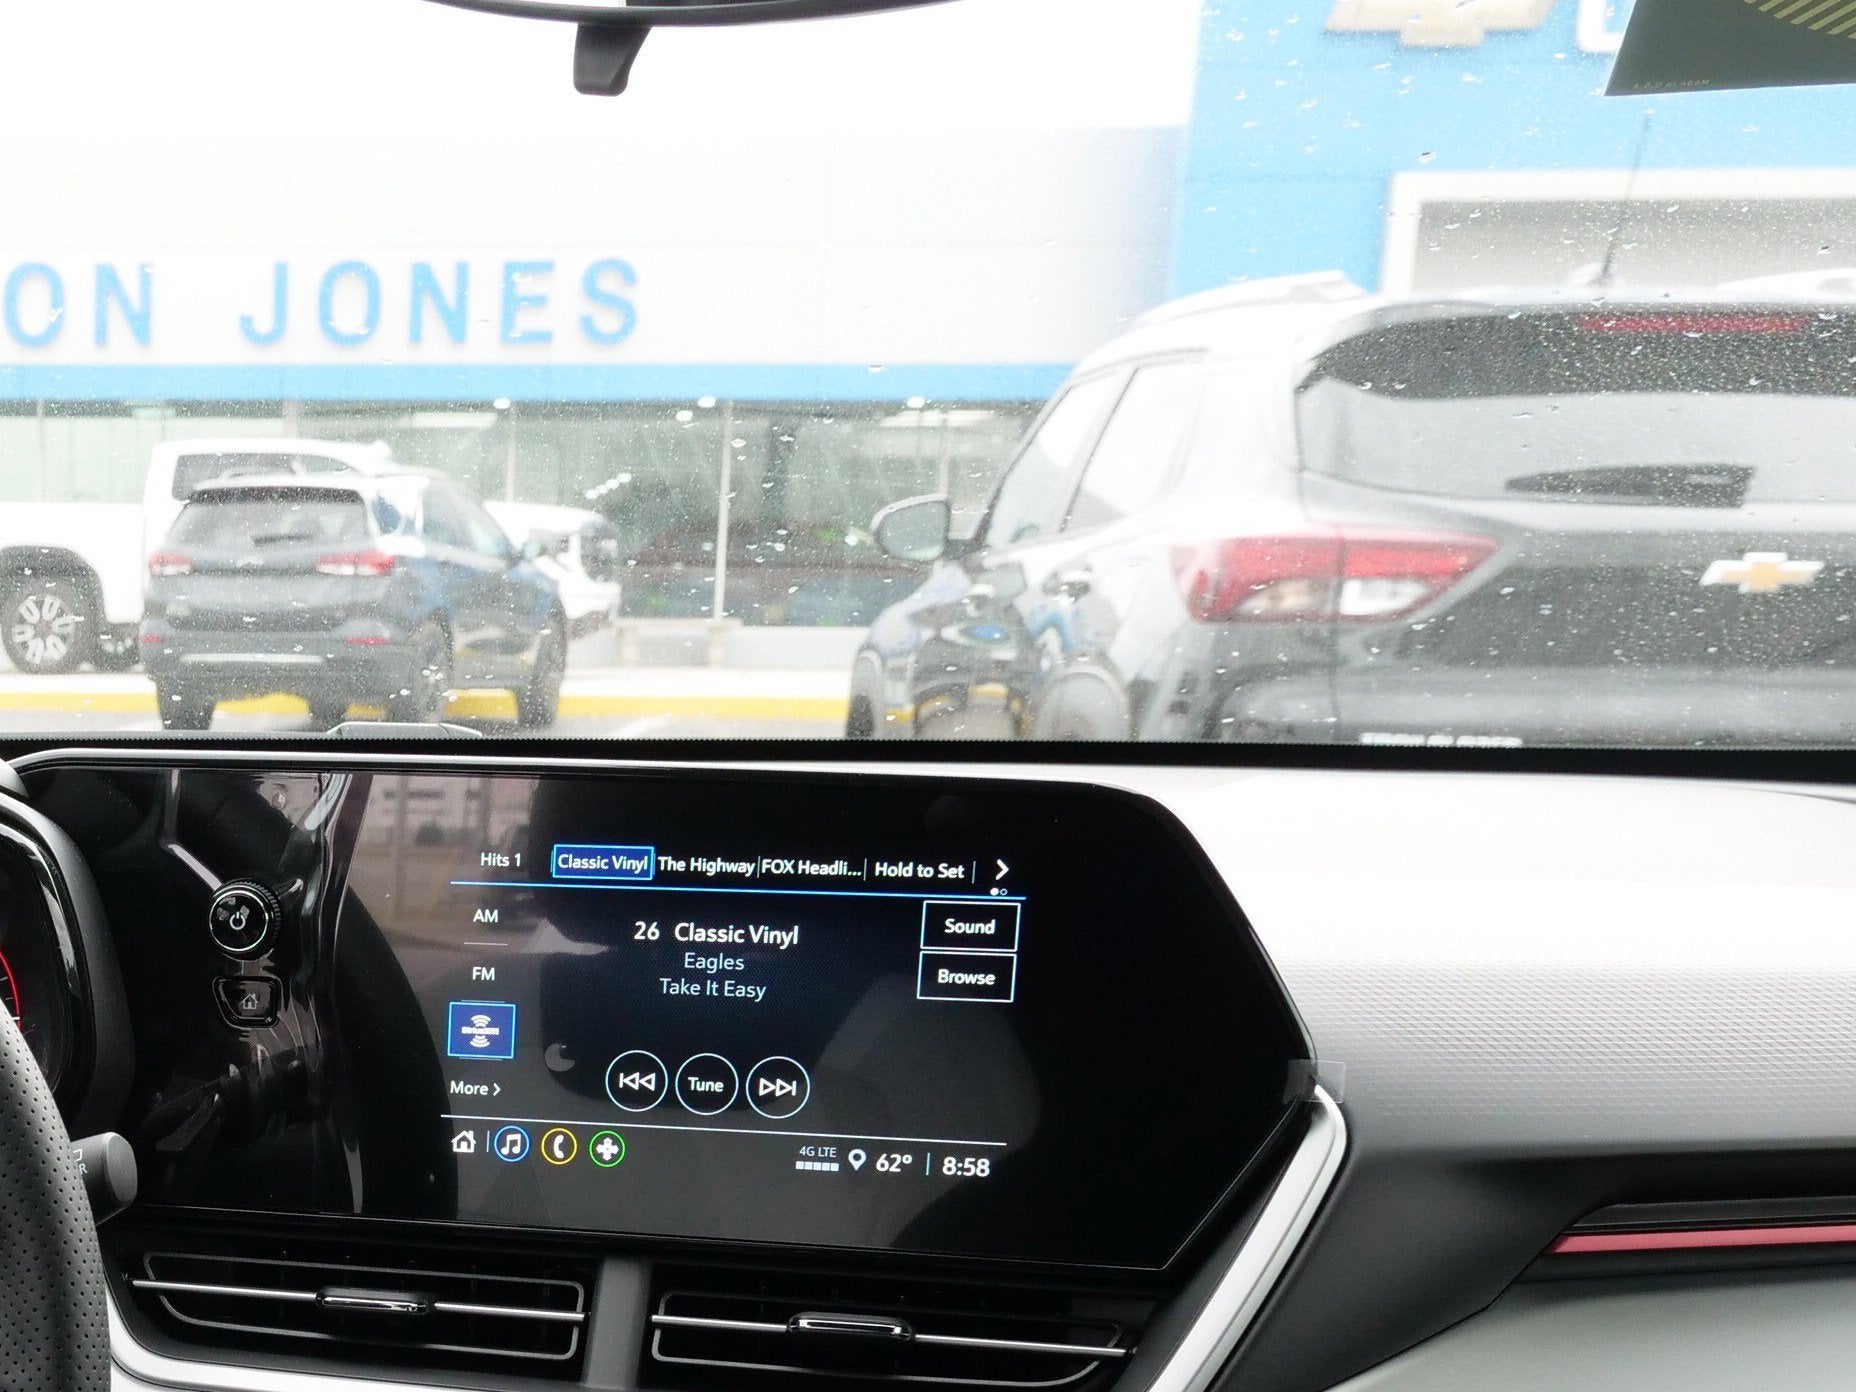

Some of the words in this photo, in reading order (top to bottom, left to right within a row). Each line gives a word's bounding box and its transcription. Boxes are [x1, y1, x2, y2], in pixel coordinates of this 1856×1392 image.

[239, 258, 640, 348] JONES
[480, 852, 510, 867] Hits
[514, 852, 522, 867] 1
[557, 853, 609, 870] Classic
[611, 855, 648, 874] Vinyl
[657, 856, 686, 872] The
[690, 857, 756, 876] Highway
[761, 858, 795, 875] FOX
[875, 862, 913, 878] Hold
[917, 864, 934, 878] to
[937, 863, 965, 879] Set
[472, 909, 499, 923] AM
[944, 918, 996, 935] Sound
[634, 921, 660, 940] 26
[674, 922, 745, 943] Classic
[748, 924, 799, 950] Vinyl
[684, 953, 745, 974] Eagles
[472, 967, 496, 981] FM
[937, 968, 996, 986] Browse
[660, 977, 701, 996] Take
[706, 978, 721, 997] It
[724, 981, 767, 1002] Easy
[450, 1080, 489, 1096] More
[687, 1077, 724, 1093] Tune
[799, 1145, 815, 1158] 4G
[818, 1146, 837, 1158] LTE
[942, 1156, 990, 1177] 8:58
